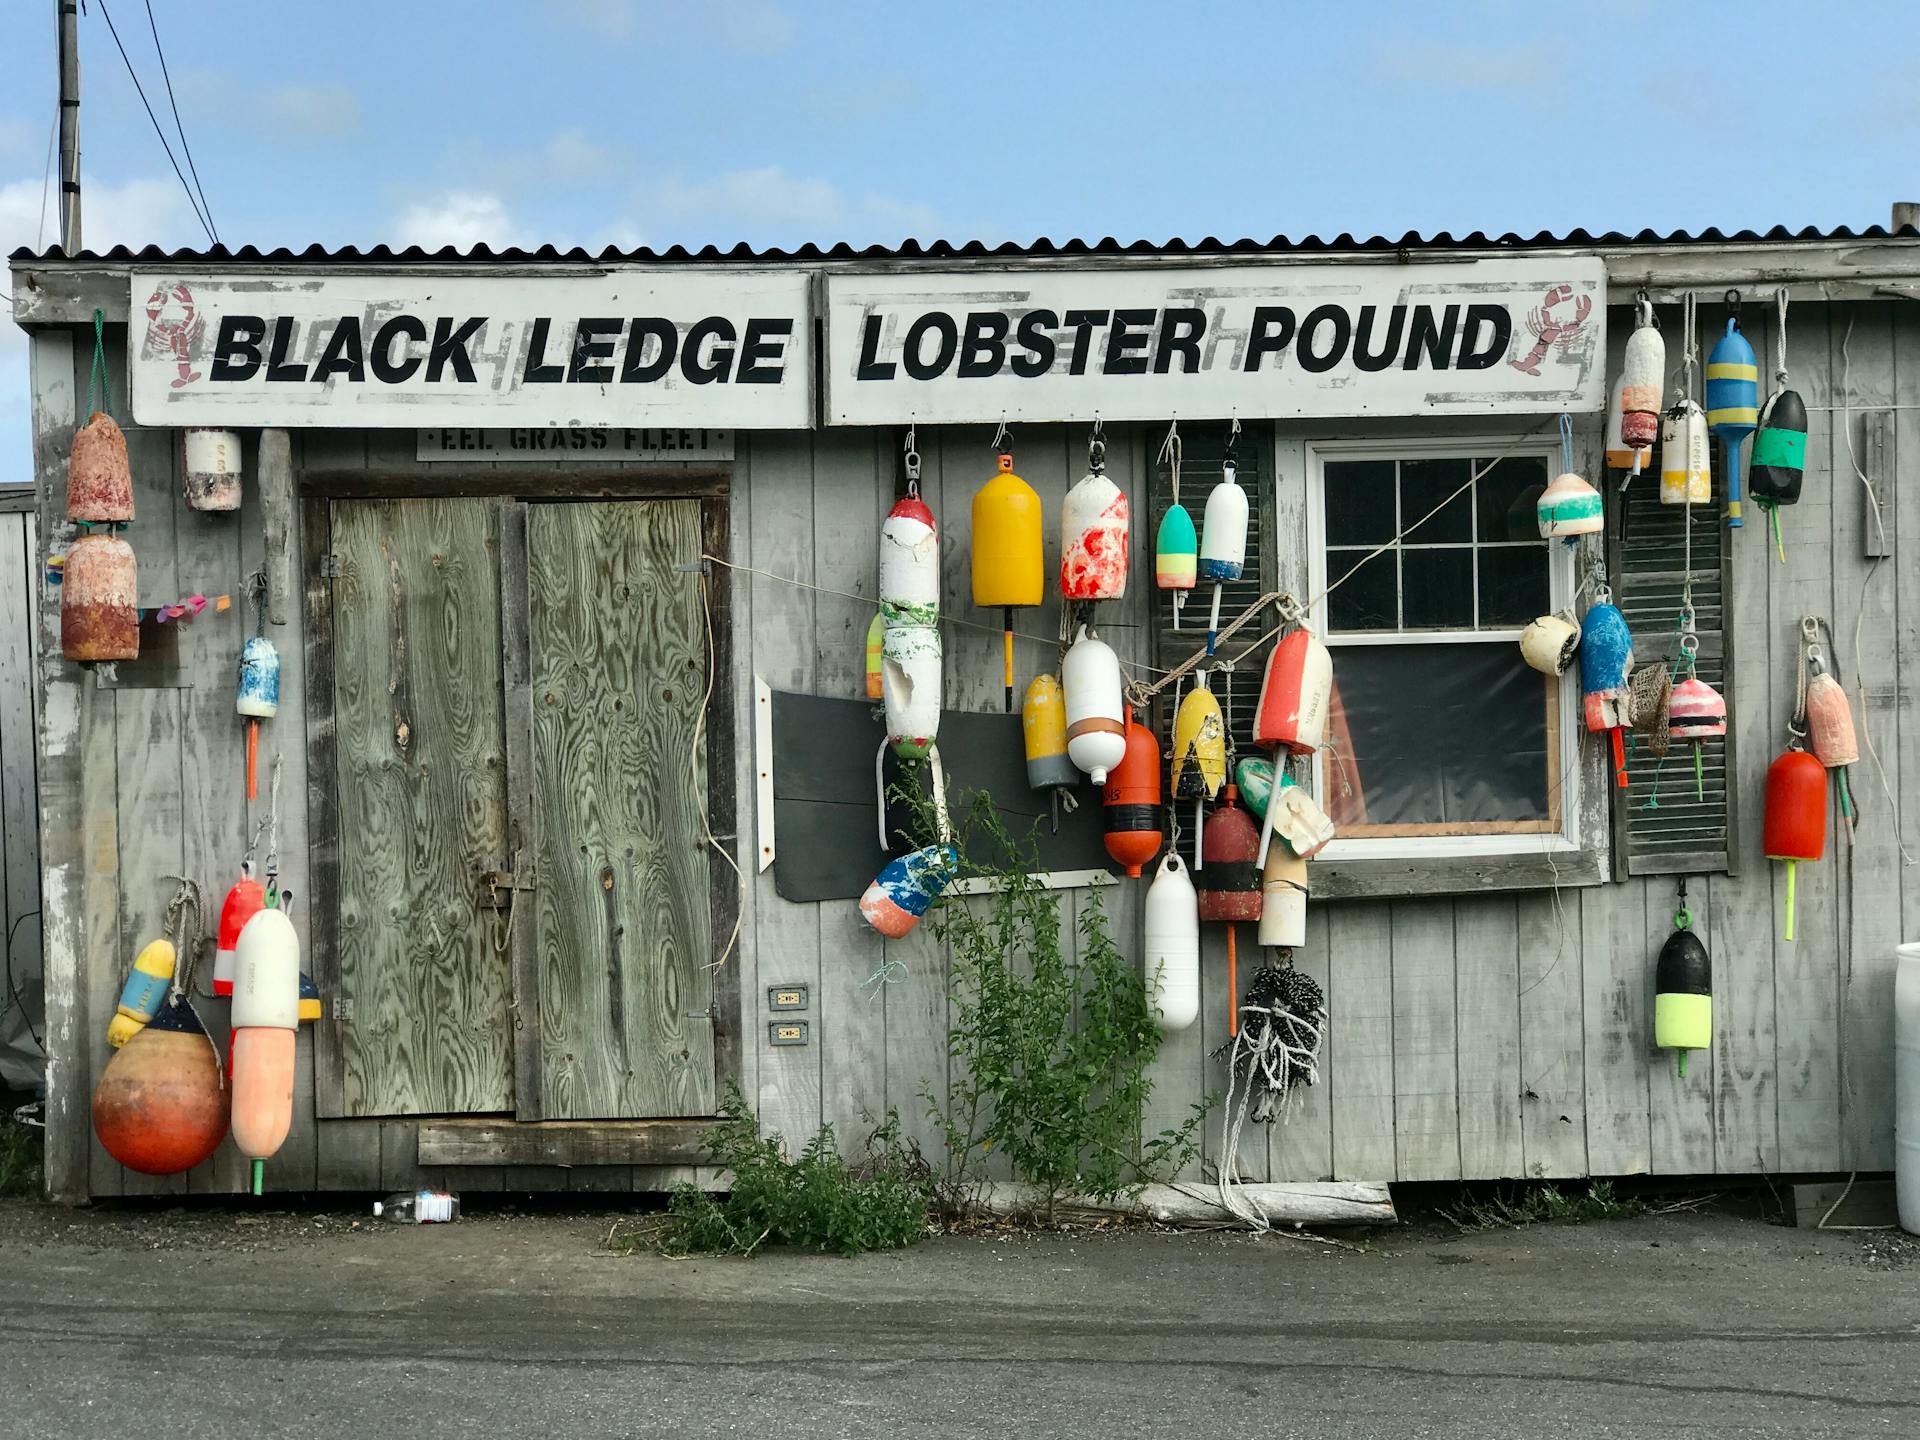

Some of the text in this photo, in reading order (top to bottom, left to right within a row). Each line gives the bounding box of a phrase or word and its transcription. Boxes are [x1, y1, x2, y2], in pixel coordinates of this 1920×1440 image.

[210, 315, 794, 385] BLACK LEDGE
[856, 304, 1512, 381] LOBSTER POUND
[441, 428, 708, 450] EEL GRASS FLEET
